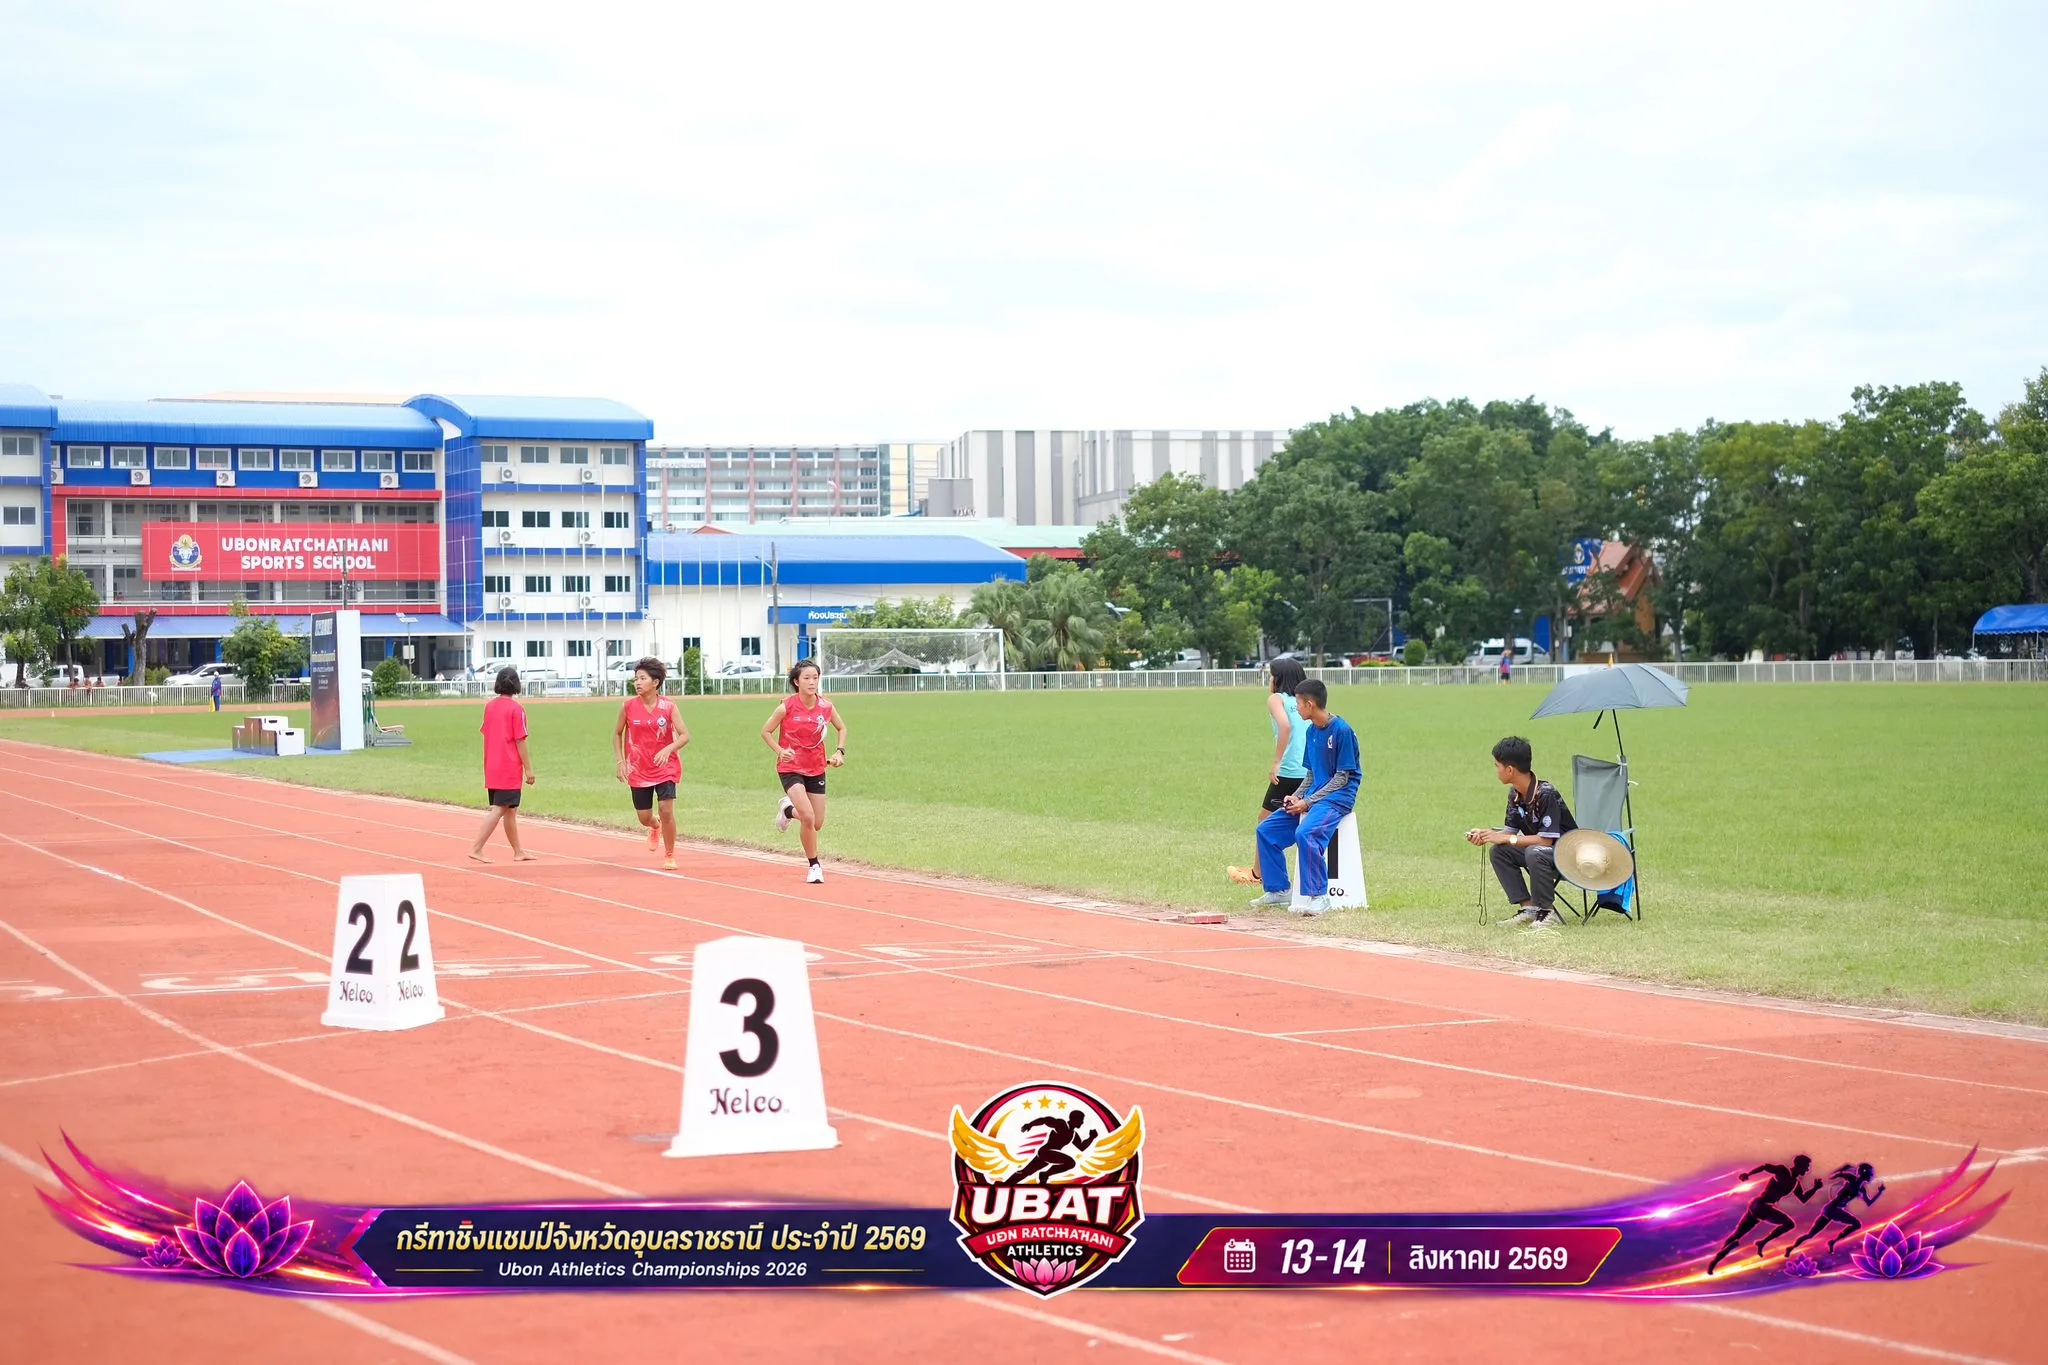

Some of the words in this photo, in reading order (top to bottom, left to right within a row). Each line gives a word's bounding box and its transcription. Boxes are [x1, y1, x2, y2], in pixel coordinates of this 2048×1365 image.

[221, 537, 388, 552] UBONRATCHATHANI
[241, 556, 304, 570] SPORTS
[313, 556, 376, 570] SCHOOL
[344, 901, 375, 975] 2
[396, 899, 420, 974] 2
[339, 980, 373, 1004] Nelco
[397, 980, 424, 1002] Nelco
[719, 977, 780, 1078] 3
[709, 1087, 783, 1116] Nelco
